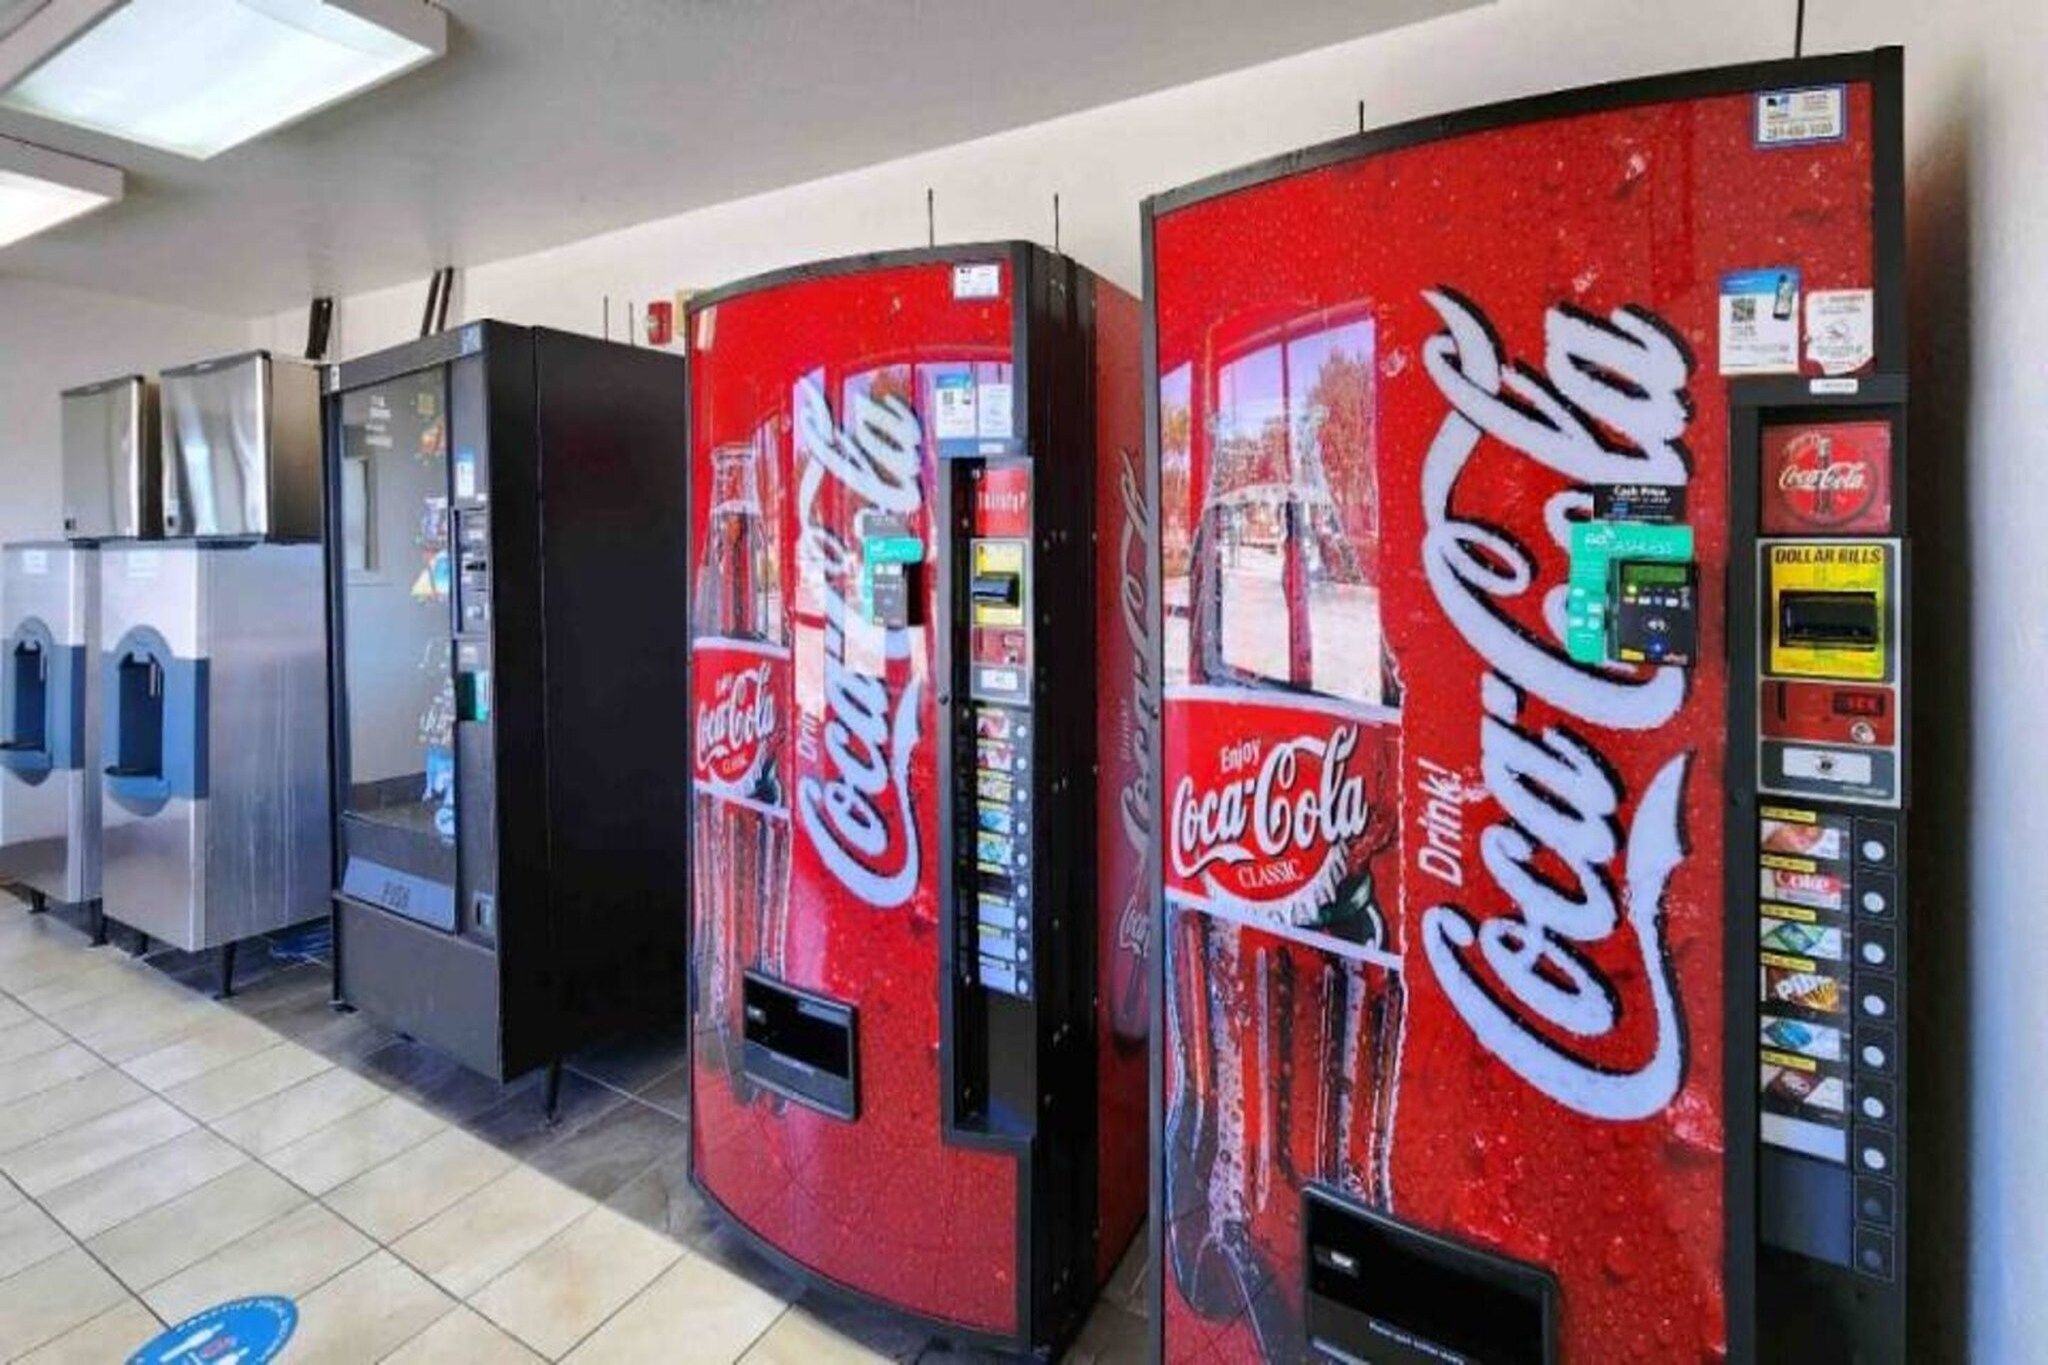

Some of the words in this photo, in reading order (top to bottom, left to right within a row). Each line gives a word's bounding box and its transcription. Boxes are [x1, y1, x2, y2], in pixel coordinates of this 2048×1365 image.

[1780, 462, 1865, 491] Coca-Cola
[1775, 548, 1835, 564] DOLLAR
[1837, 549, 1881, 564] BILLS
[697, 661, 775, 771] Coca-Cola
[1220, 738, 1262, 774] Enjoy
[1171, 722, 1368, 878] Coca-Cola
[1417, 756, 1462, 887] Drink!
[1238, 859, 1304, 888] CLASSIC
